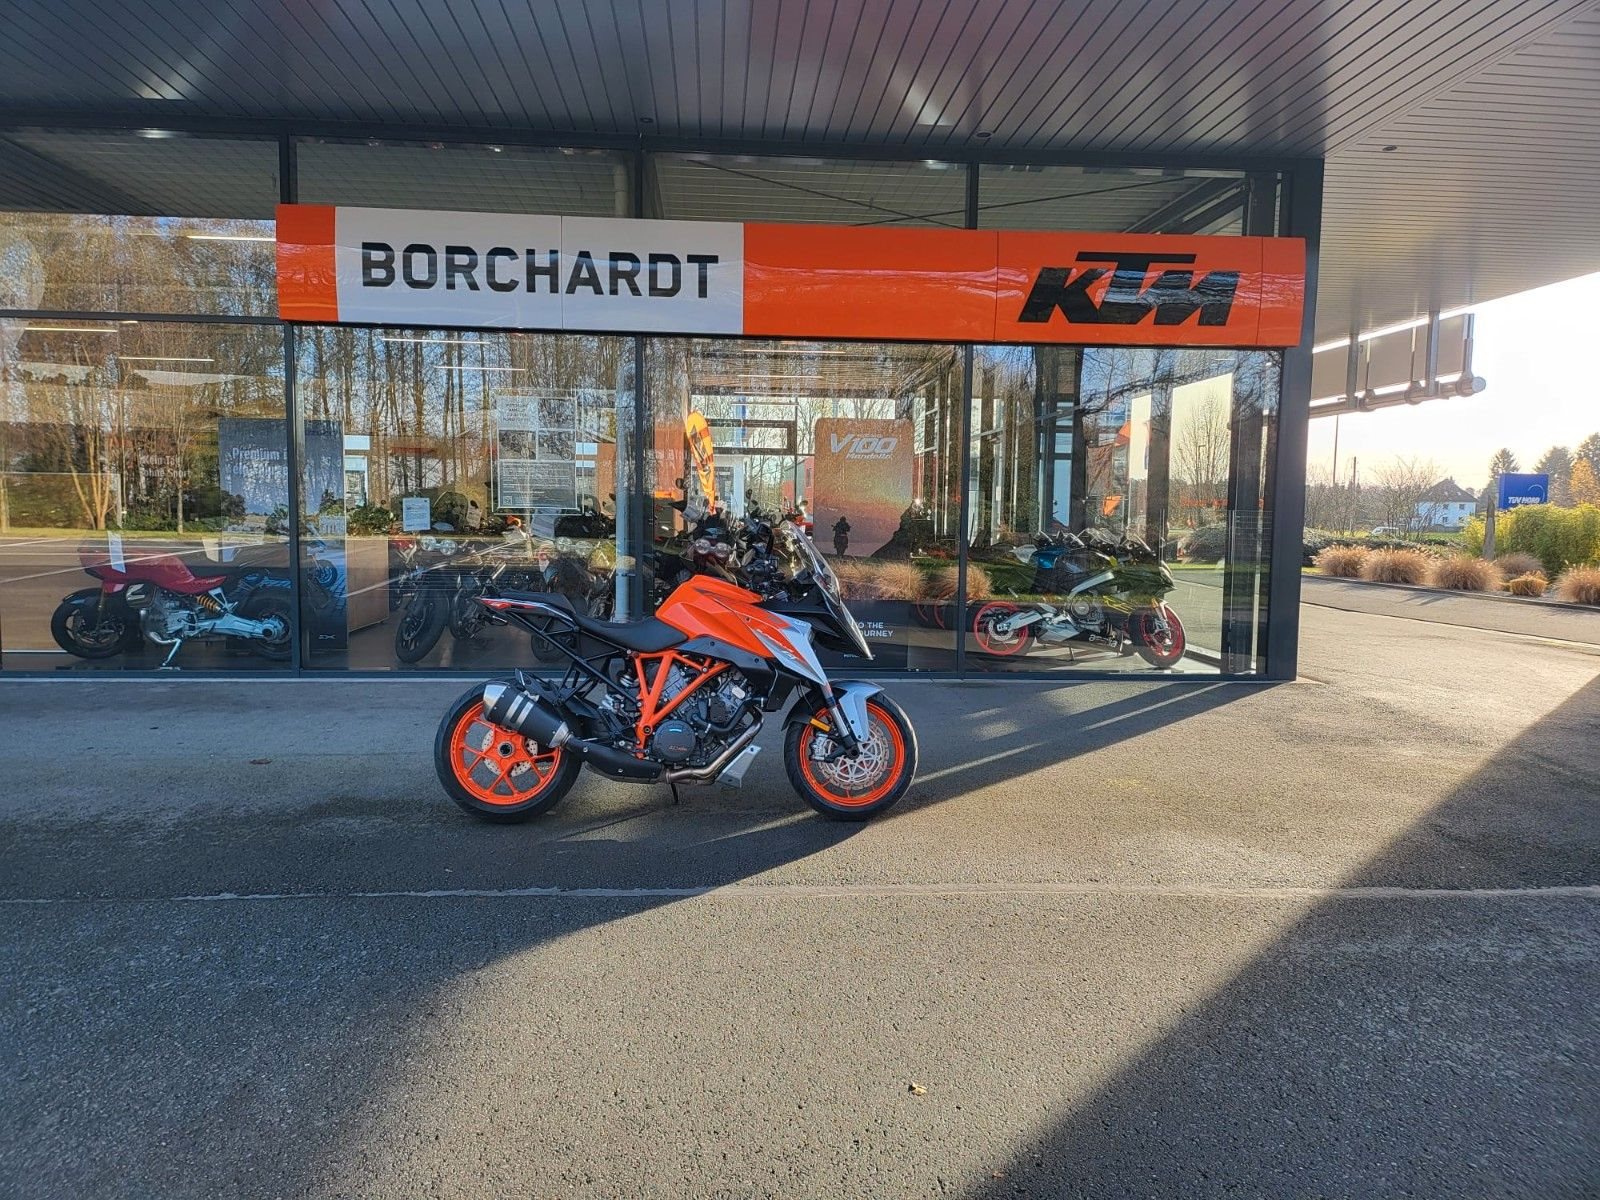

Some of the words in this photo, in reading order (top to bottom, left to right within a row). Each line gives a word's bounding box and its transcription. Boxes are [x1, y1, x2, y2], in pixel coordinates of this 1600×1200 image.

[362, 242, 719, 299] BORCHARDT
[1019, 251, 1241, 328] KTM
[831, 433, 897, 453] V100
[232, 447, 280, 461] Premium
[1521, 496, 1541, 504] NORD
[867, 621, 884, 629] THE
[859, 629, 893, 637] OURNEY
